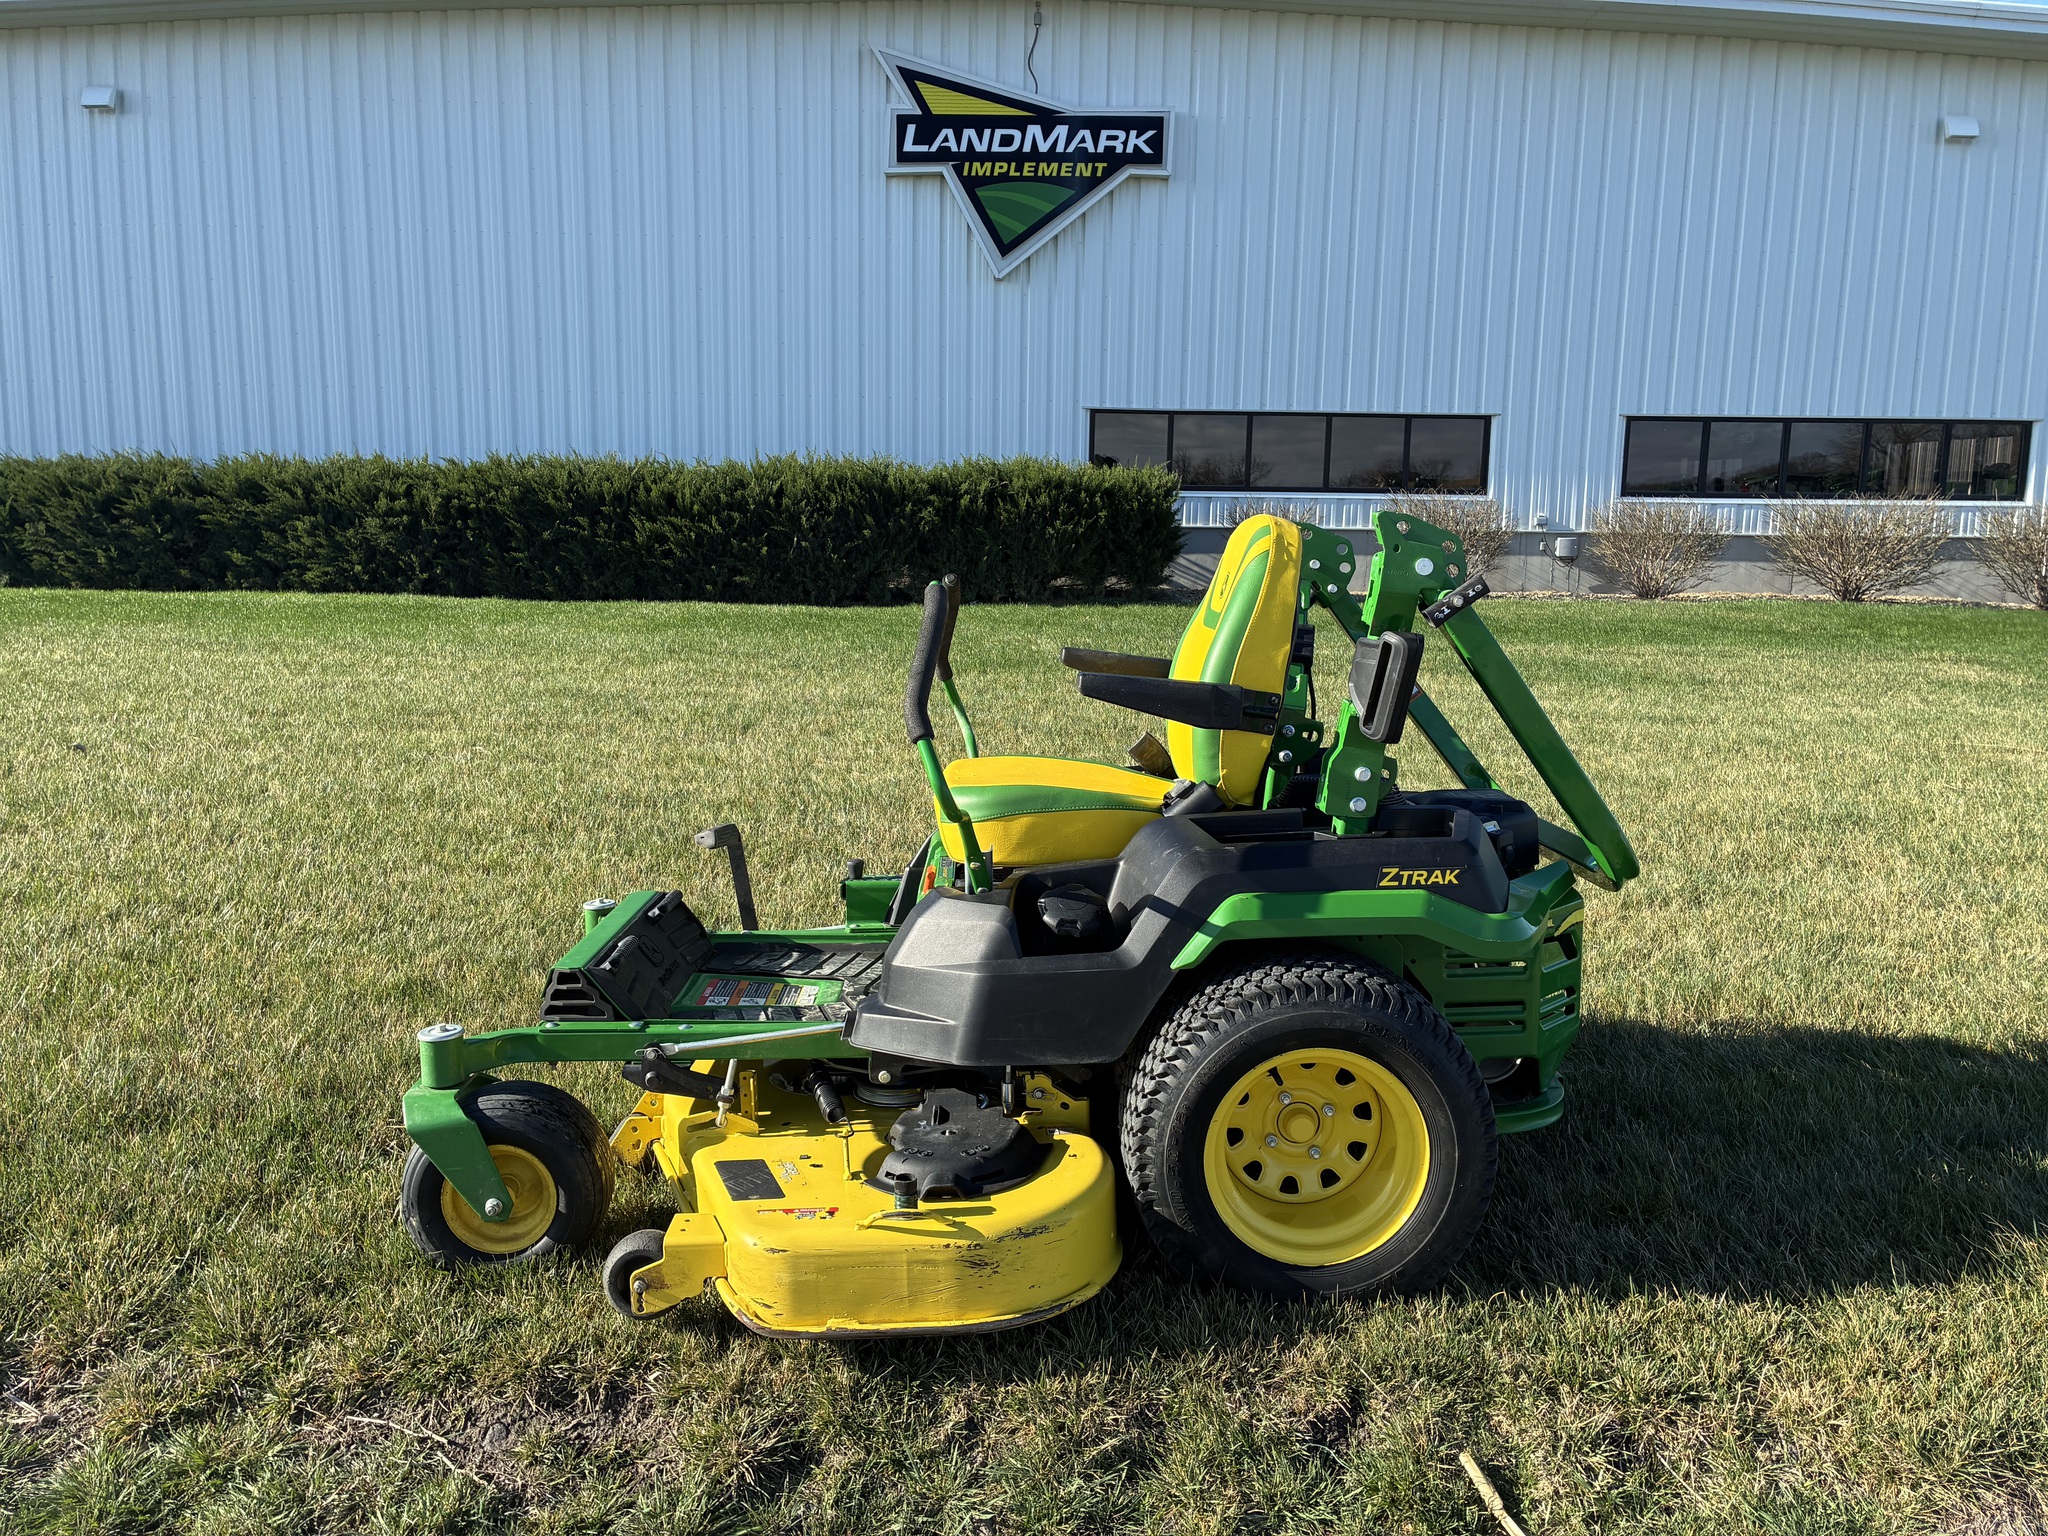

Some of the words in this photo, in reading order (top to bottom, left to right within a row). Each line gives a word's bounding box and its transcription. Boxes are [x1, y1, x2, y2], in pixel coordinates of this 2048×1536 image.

[962, 162, 1108, 177] IMPLEMENT
[1379, 867, 1461, 887] ZTRAK
[1360, 1018, 1434, 1076] KENDA
